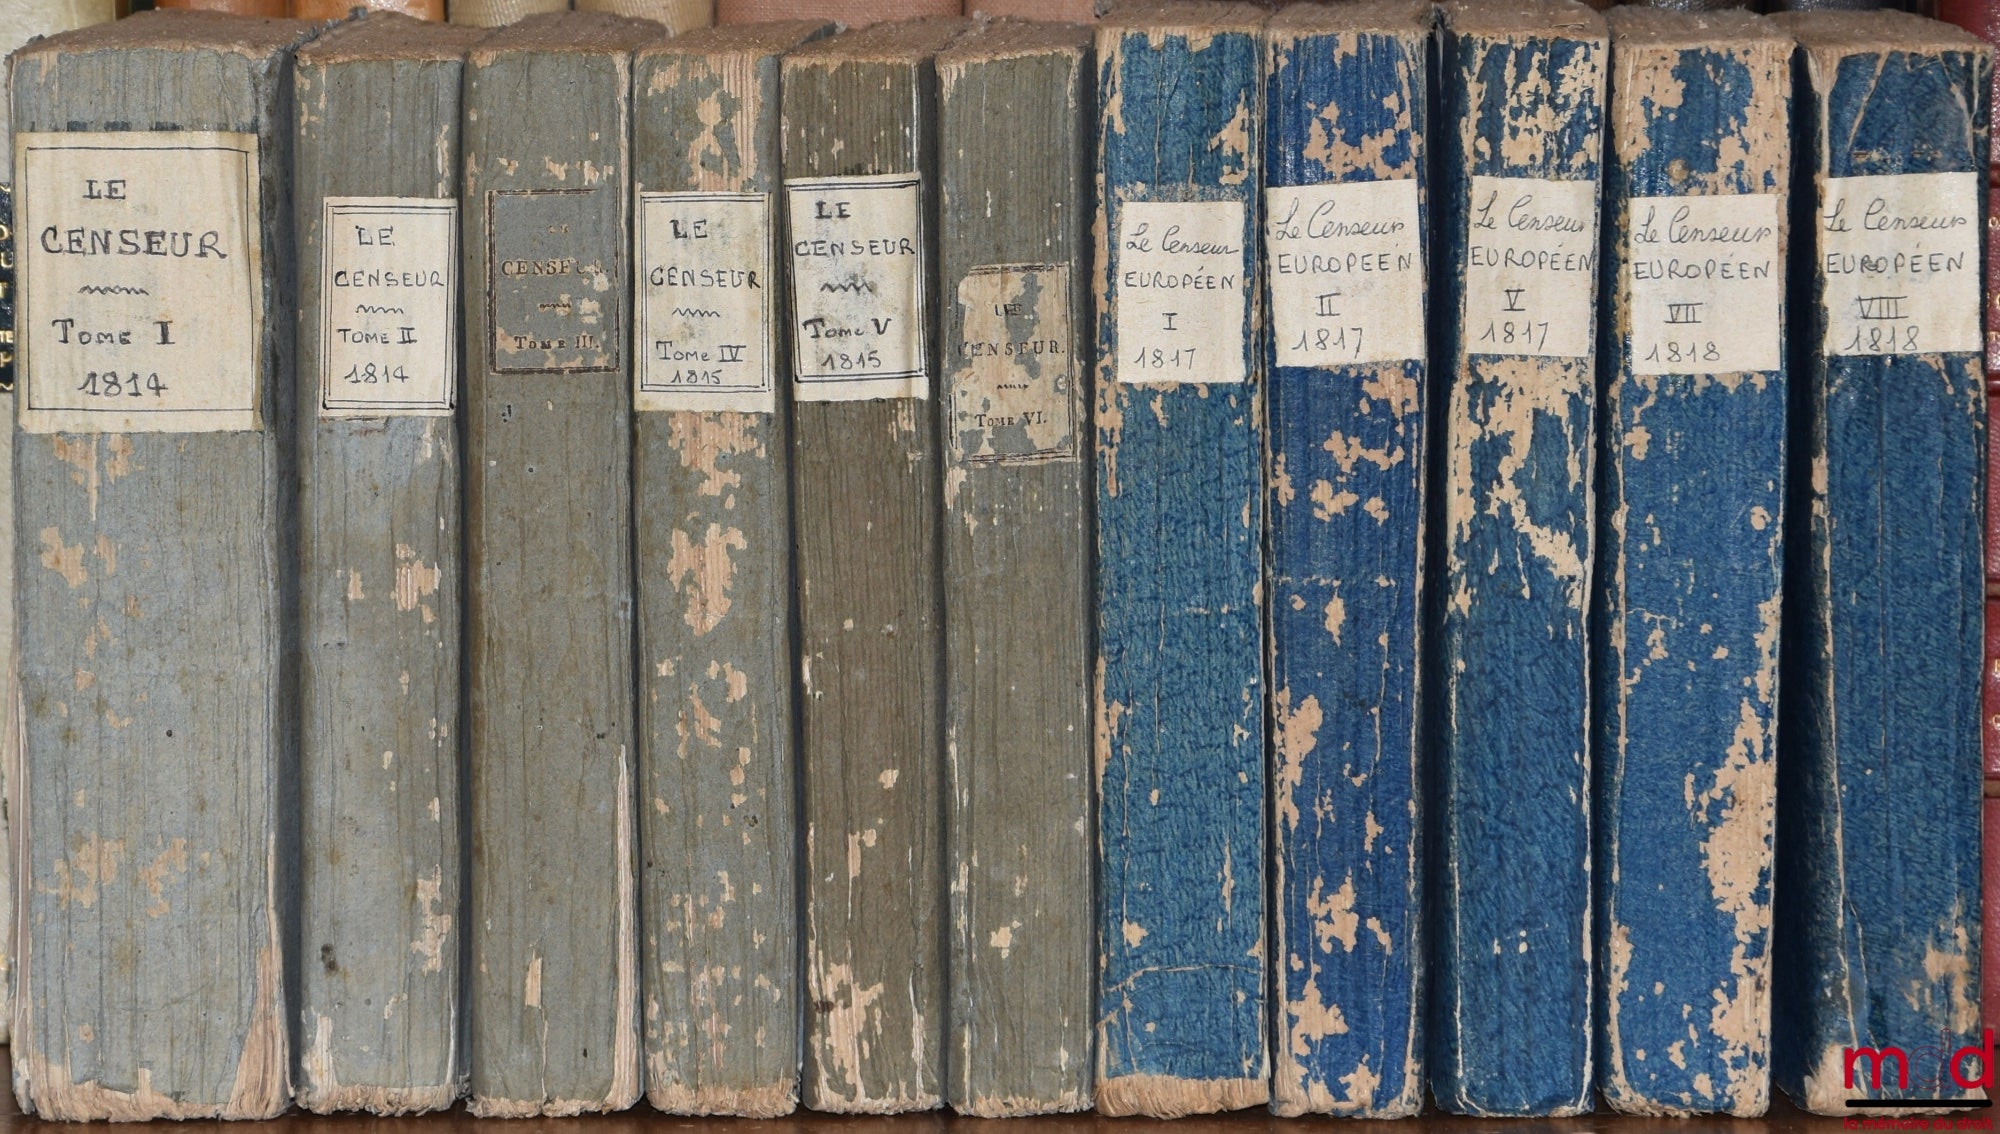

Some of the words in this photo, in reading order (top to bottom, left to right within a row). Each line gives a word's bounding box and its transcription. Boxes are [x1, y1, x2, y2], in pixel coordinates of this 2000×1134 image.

[81, 179, 127, 201] LE
[814, 199, 852, 221] LE
[1276, 200, 1302, 241] Le
[1307, 199, 1405, 239] Censeur
[1473, 189, 1498, 230] Le
[1507, 194, 1585, 233] Censeur
[1824, 197, 1852, 233] Le
[1863, 197, 1967, 232] Censeur
[354, 224, 396, 247] LE
[668, 218, 709, 241] LE
[1633, 205, 1660, 244] Le
[1668, 205, 1772, 244] Censeur
[40, 224, 228, 260] CENSEUR
[794, 237, 916, 257] CENSEUR
[1125, 222, 1153, 251] Le
[1161, 224, 1240, 255] Censeur
[1471, 244, 1591, 272] EUROPÉEN
[1633, 253, 1770, 280] EUROPÉEN
[1827, 243, 1965, 275] EUROPÉEN
[334, 269, 445, 288] CENSEUR
[649, 264, 761, 290] CENSEUR
[1124, 265, 1235, 290] EUROPÉEN
[1314, 291, 1342, 317] II
[1502, 288, 1526, 312] V
[1854, 295, 1909, 321] VIII
[1161, 312, 1178, 331] I
[1663, 302, 1704, 325] VII
[152, 319, 176, 346] I
[396, 326, 418, 345] II
[870, 317, 893, 336] V
[1480, 320, 1549, 352] 1817
[1845, 325, 1920, 352] 1818
[717, 344, 747, 363] IV
[1291, 326, 1363, 360] 1817
[1644, 341, 1721, 363] 1818
[820, 349, 882, 371] 1815
[1133, 346, 1197, 370] 1817
[76, 370, 169, 399] 1814
[343, 362, 410, 385] 1814
[670, 368, 723, 385] 1815
[1021, 409, 1049, 428] VI.
